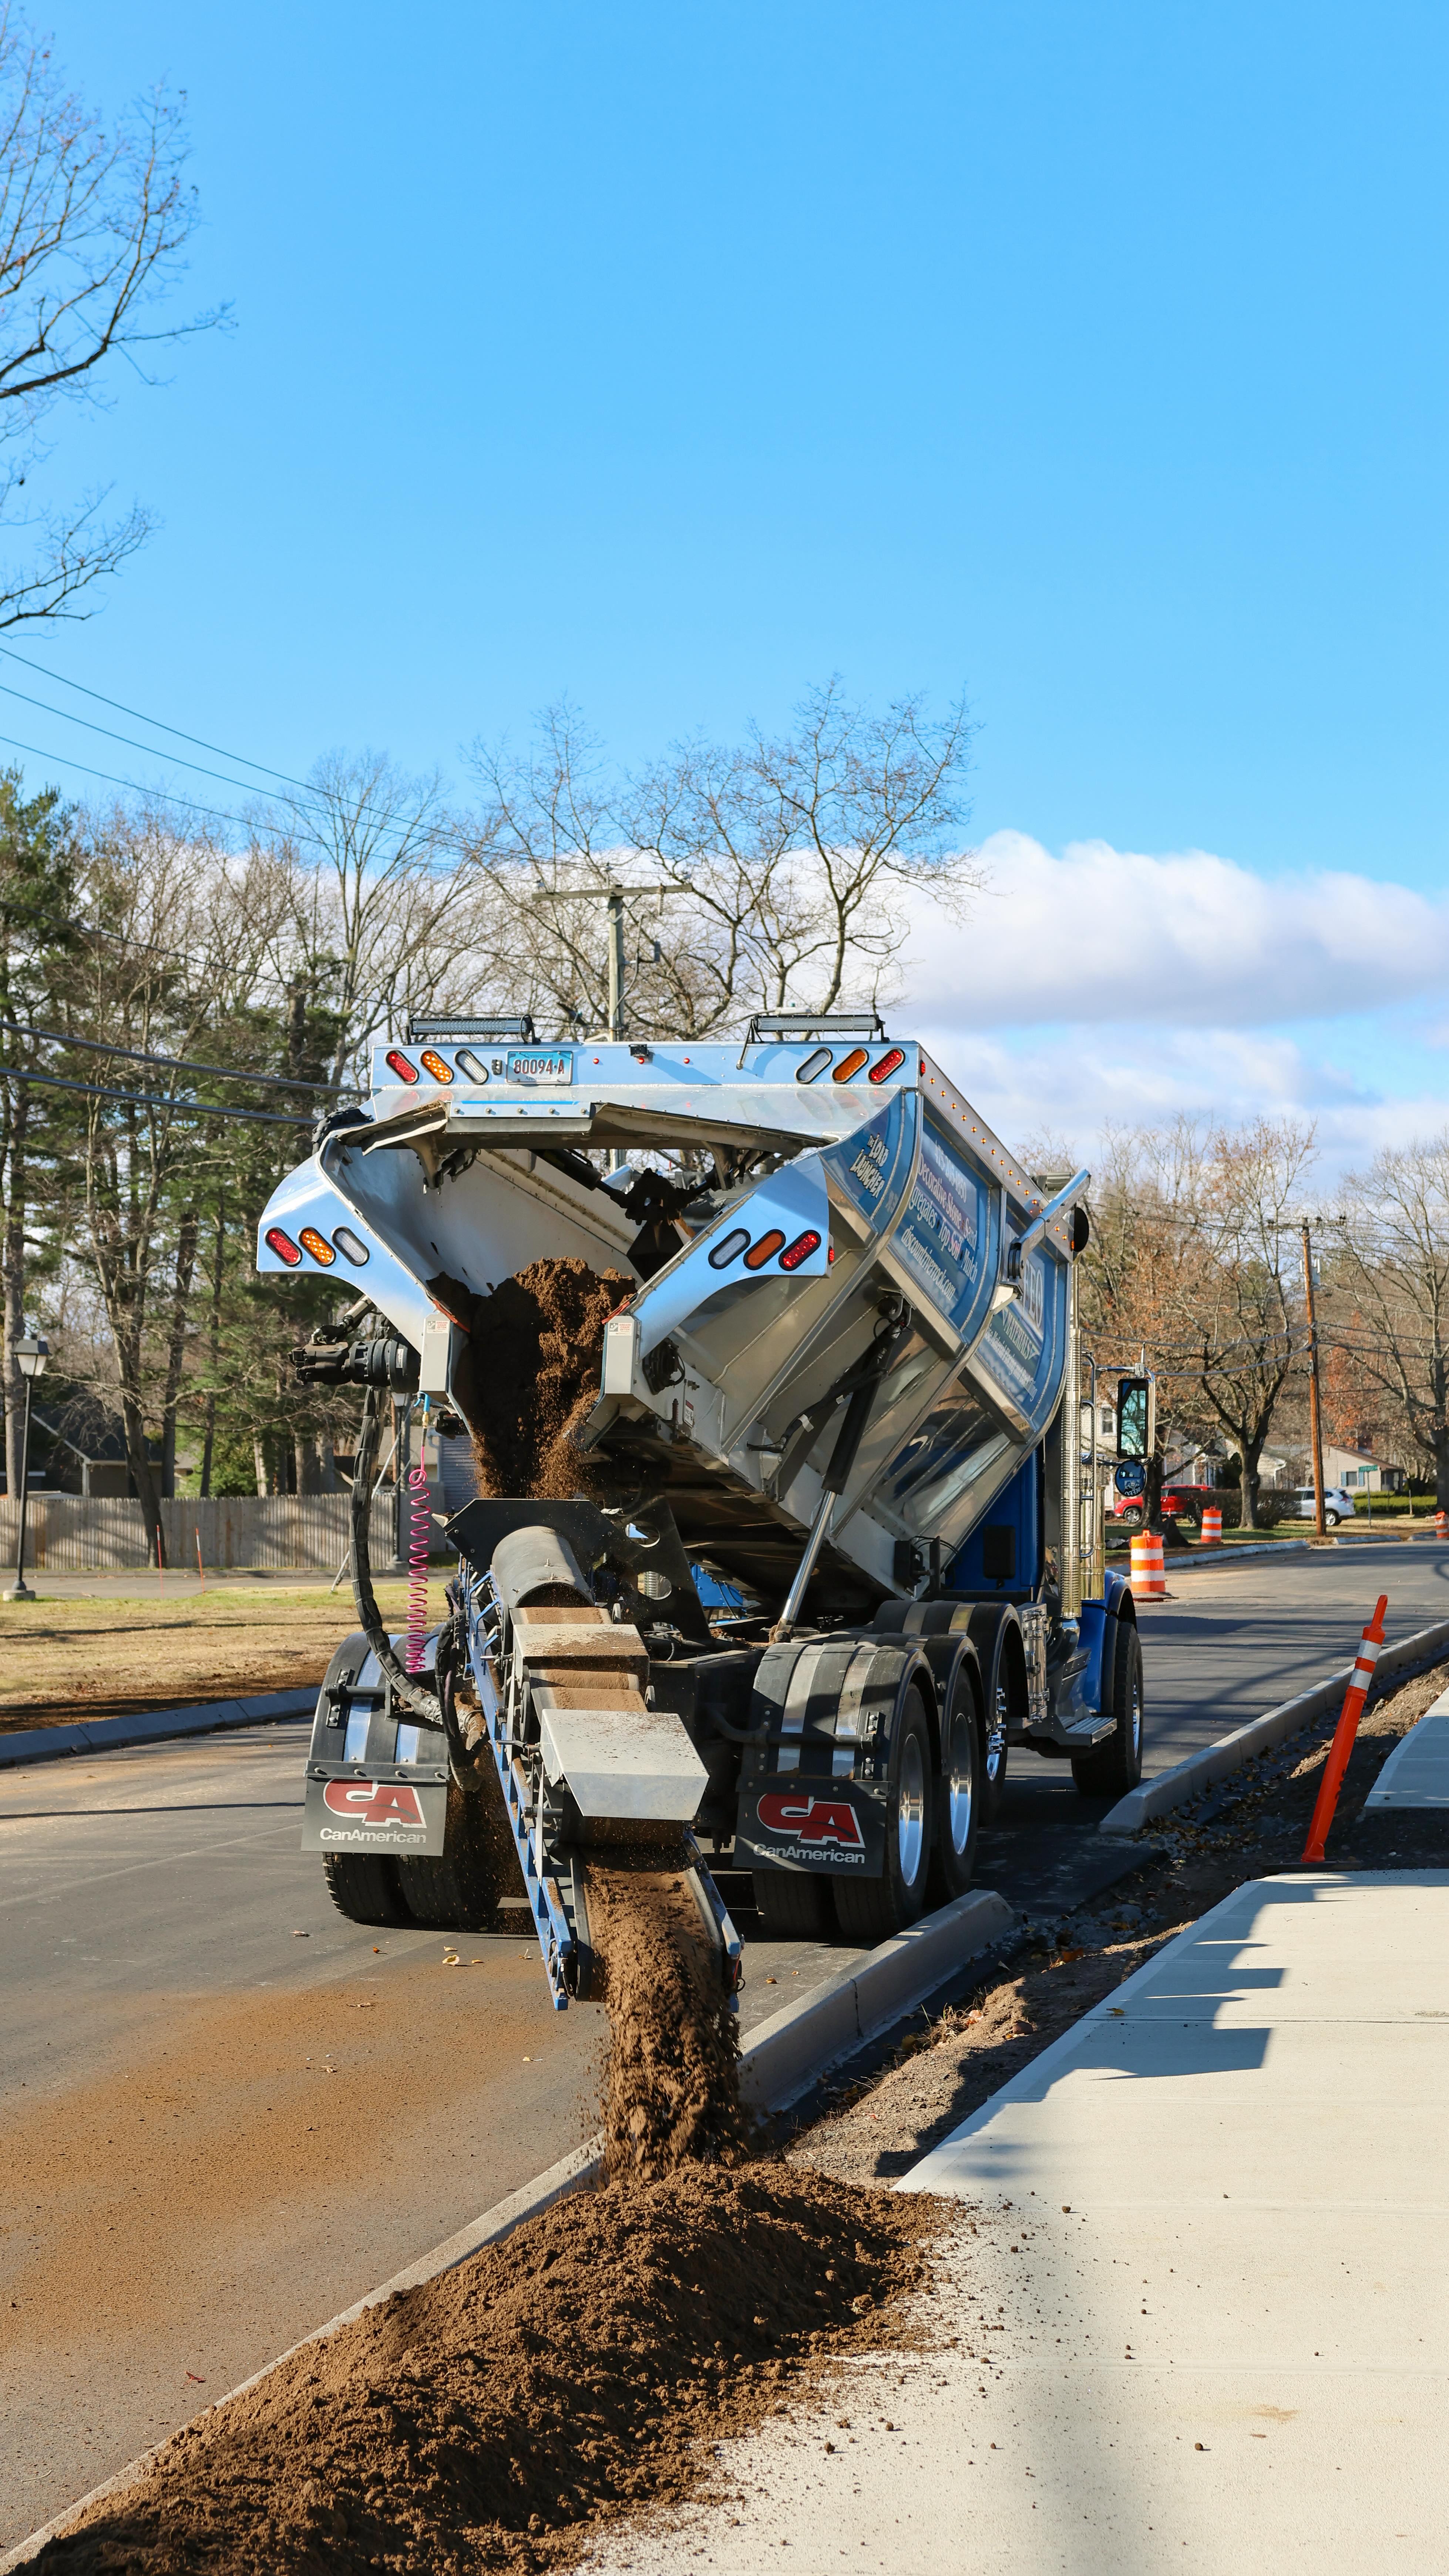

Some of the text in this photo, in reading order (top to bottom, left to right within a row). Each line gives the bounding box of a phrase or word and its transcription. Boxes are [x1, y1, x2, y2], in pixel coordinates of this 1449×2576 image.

[850, 1148, 885, 1199] LAUNCHER
[869, 1133, 890, 1167] LOAD
[918, 1153, 978, 1252] Decorative Stone Sand
[901, 1225, 956, 1301] discountriverrock.com
[938, 1217, 950, 1252] Top
[948, 1231, 963, 1261] Soil
[961, 1248, 978, 1284] Mulch
[1003, 1312, 1031, 1360] MATERIALS
[319, 1828, 426, 1844] CanAmerican
[753, 1843, 865, 1864] CanAmerican
